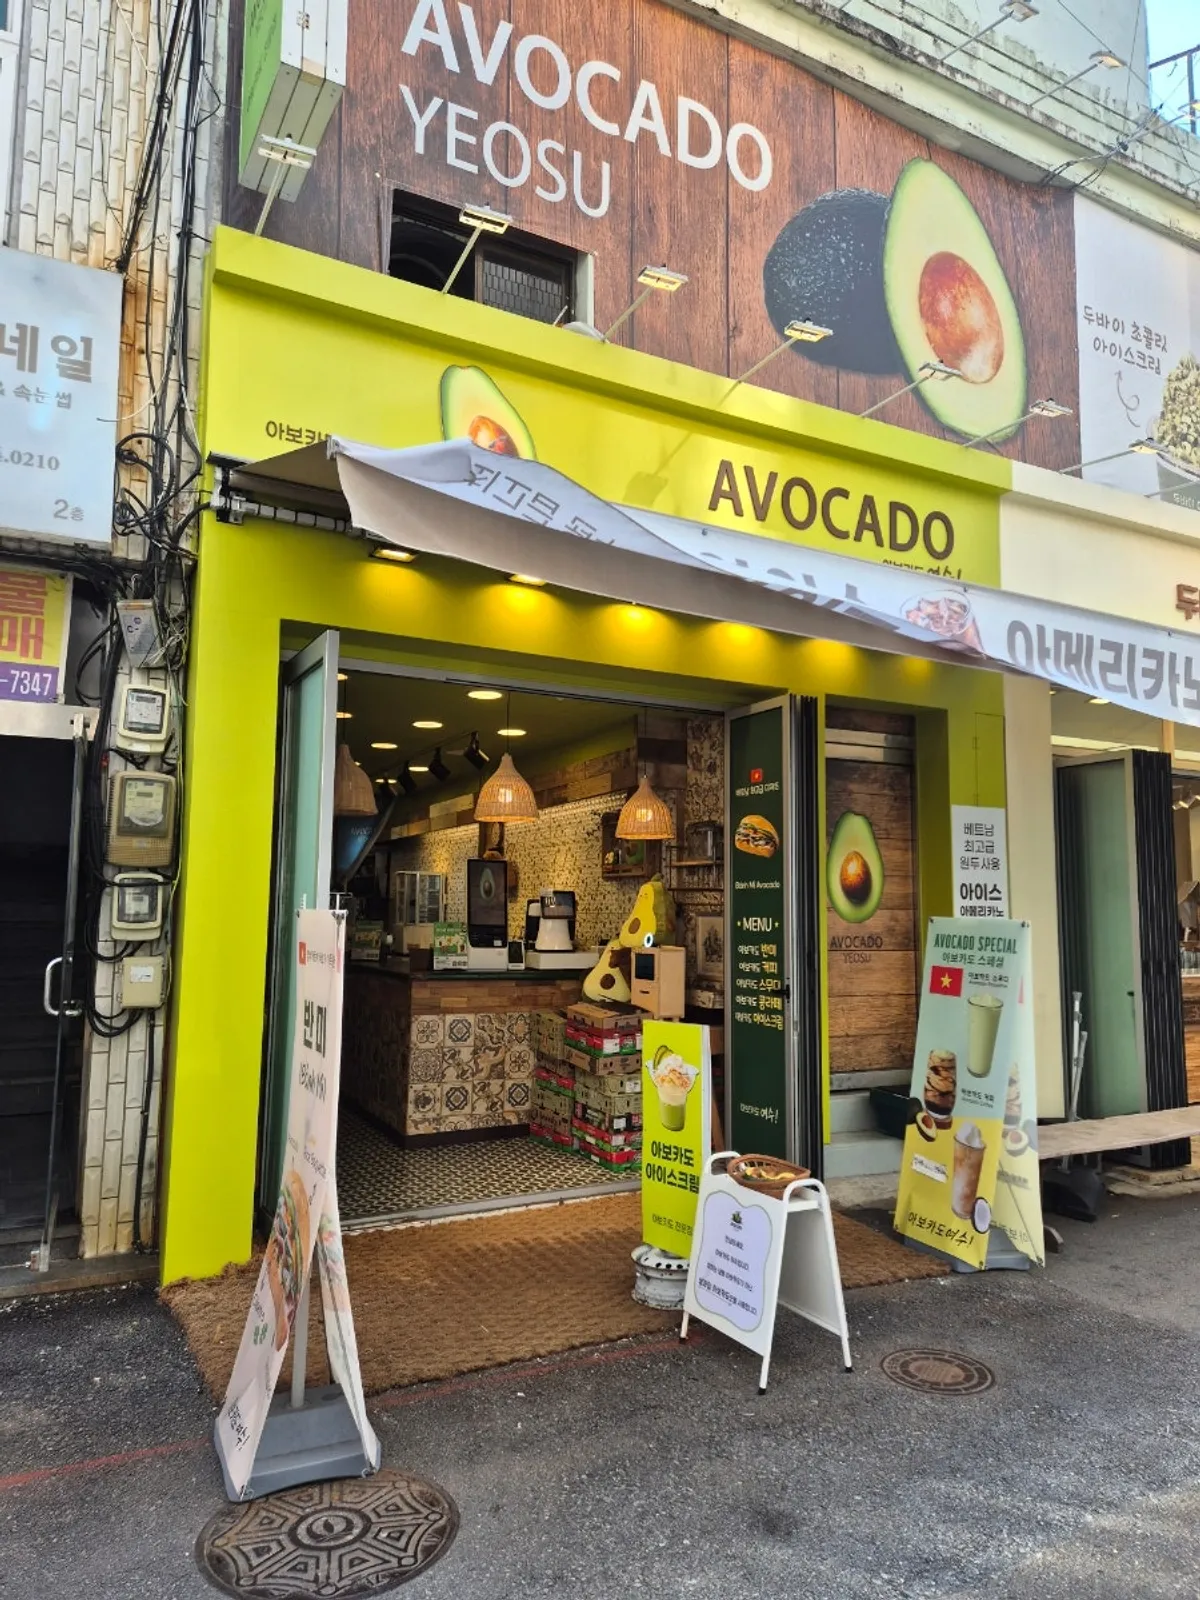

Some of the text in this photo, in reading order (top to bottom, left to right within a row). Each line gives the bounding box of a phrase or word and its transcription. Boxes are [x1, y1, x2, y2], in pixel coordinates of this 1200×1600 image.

[402, 0, 773, 191] AVOCADO
[399, 84, 610, 217] YEOSU
[1083, 305, 1168, 353] 두바이 초콜릿
[0, 322, 93, 383] 네일
[1093, 337, 1161, 374] 아이스크림
[266, 420, 330, 445] 아보카
[54, 499, 84, 521] 2층
[708, 459, 954, 560] AVOCADO
[963, 822, 994, 837] 베트남
[964, 840, 994, 854] 최고급
[960, 883, 1002, 901] 아이스
[960, 905, 1004, 917] 아메리카노
[743, 916, 772, 932] MENU
[830, 936, 883, 949] AVOCADO
[934, 933, 1018, 954] AVOCADO SPECIAL
[843, 952, 871, 963] YEOSU
[943, 952, 975, 965] 아보카도
[759, 978, 781, 992] 스무디
[303, 999, 327, 1058] 반미
[650, 1140, 694, 1168] 아보카도
[645, 1162, 699, 1195] 아이스크림
